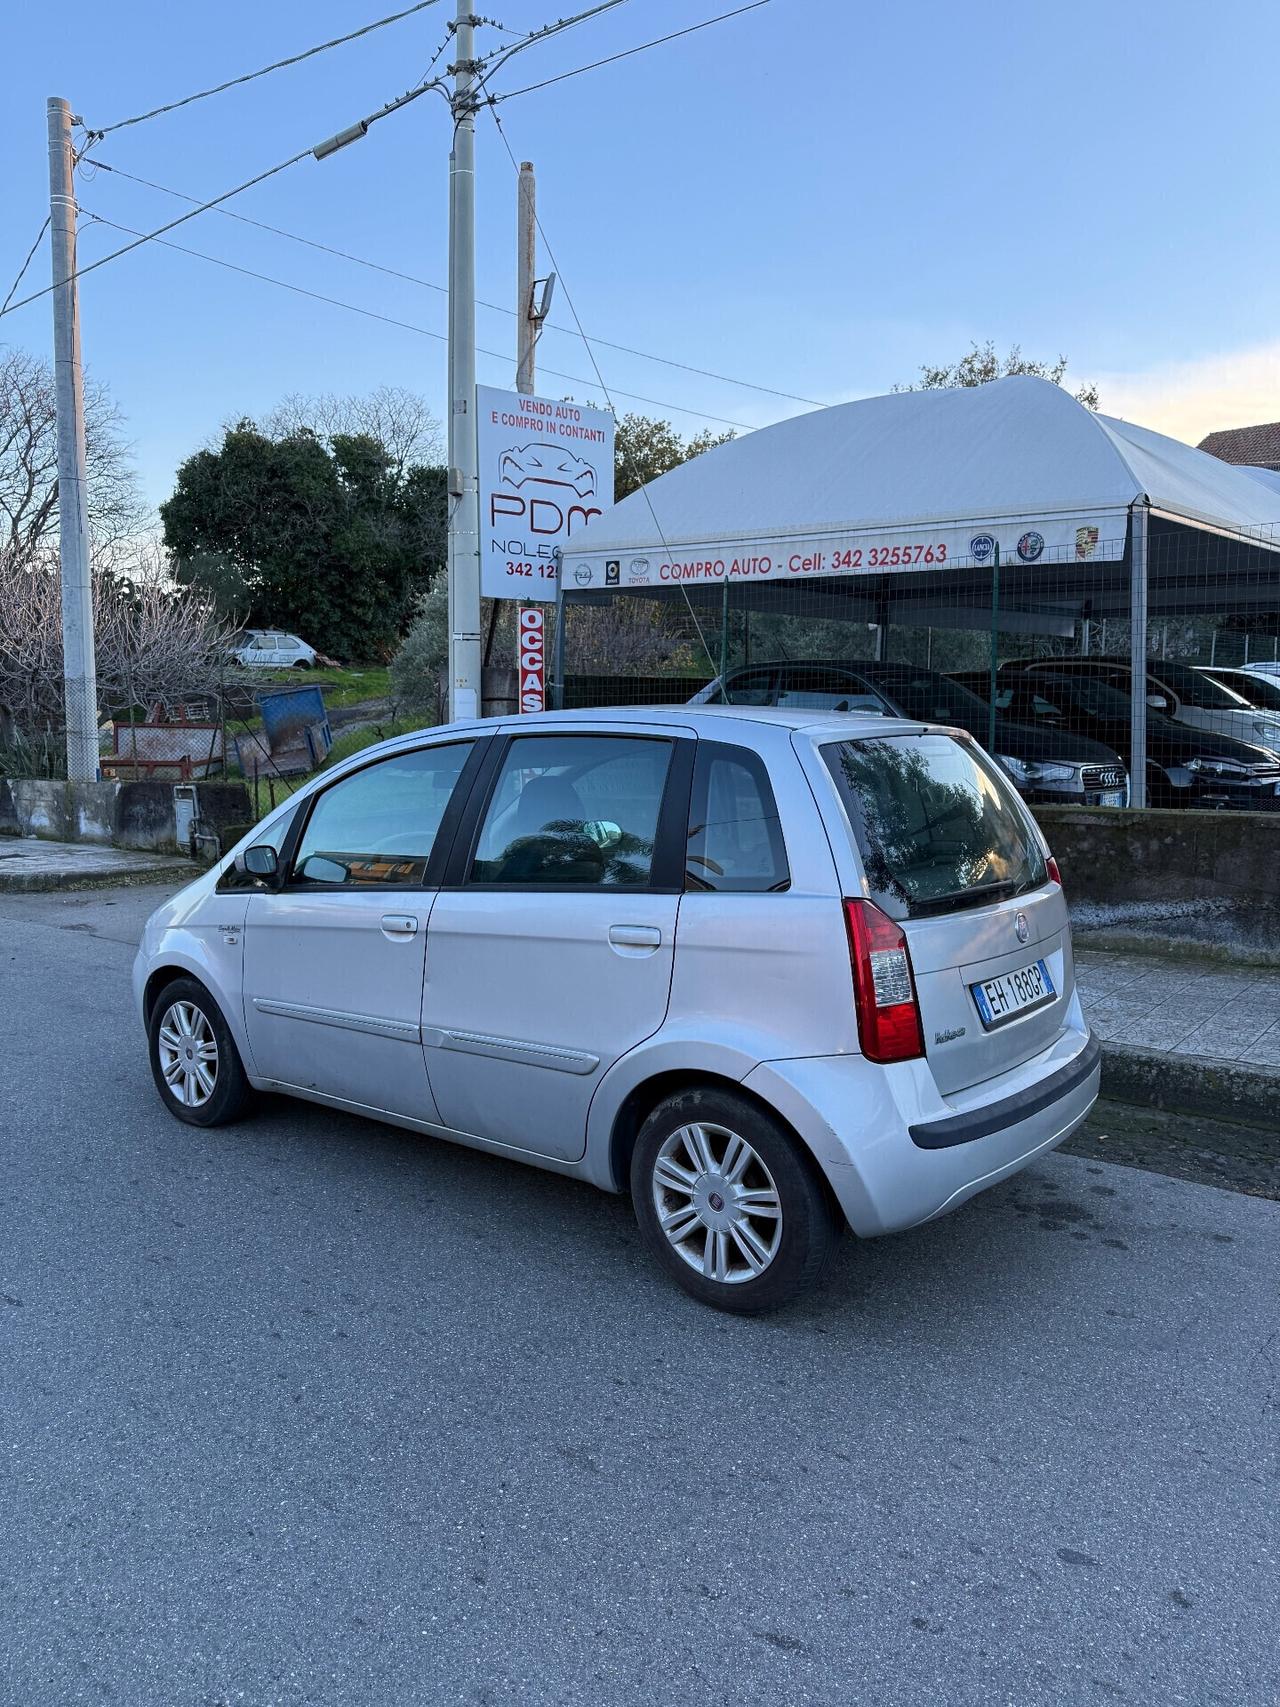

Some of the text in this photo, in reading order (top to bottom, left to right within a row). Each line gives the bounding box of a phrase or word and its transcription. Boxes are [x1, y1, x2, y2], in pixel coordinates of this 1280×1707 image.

[518, 399, 581, 422] VENDO AUTO
[492, 411, 605, 443] E COMPRO IN CONTANTI
[506, 561, 533, 577] 342
[660, 560, 725, 580] COMPRO
[729, 556, 772, 576] AUTO
[788, 553, 826, 572] Cell:
[831, 549, 862, 569] 342
[867, 543, 947, 566] 3255763
[983, 980, 1010, 1015] EH
